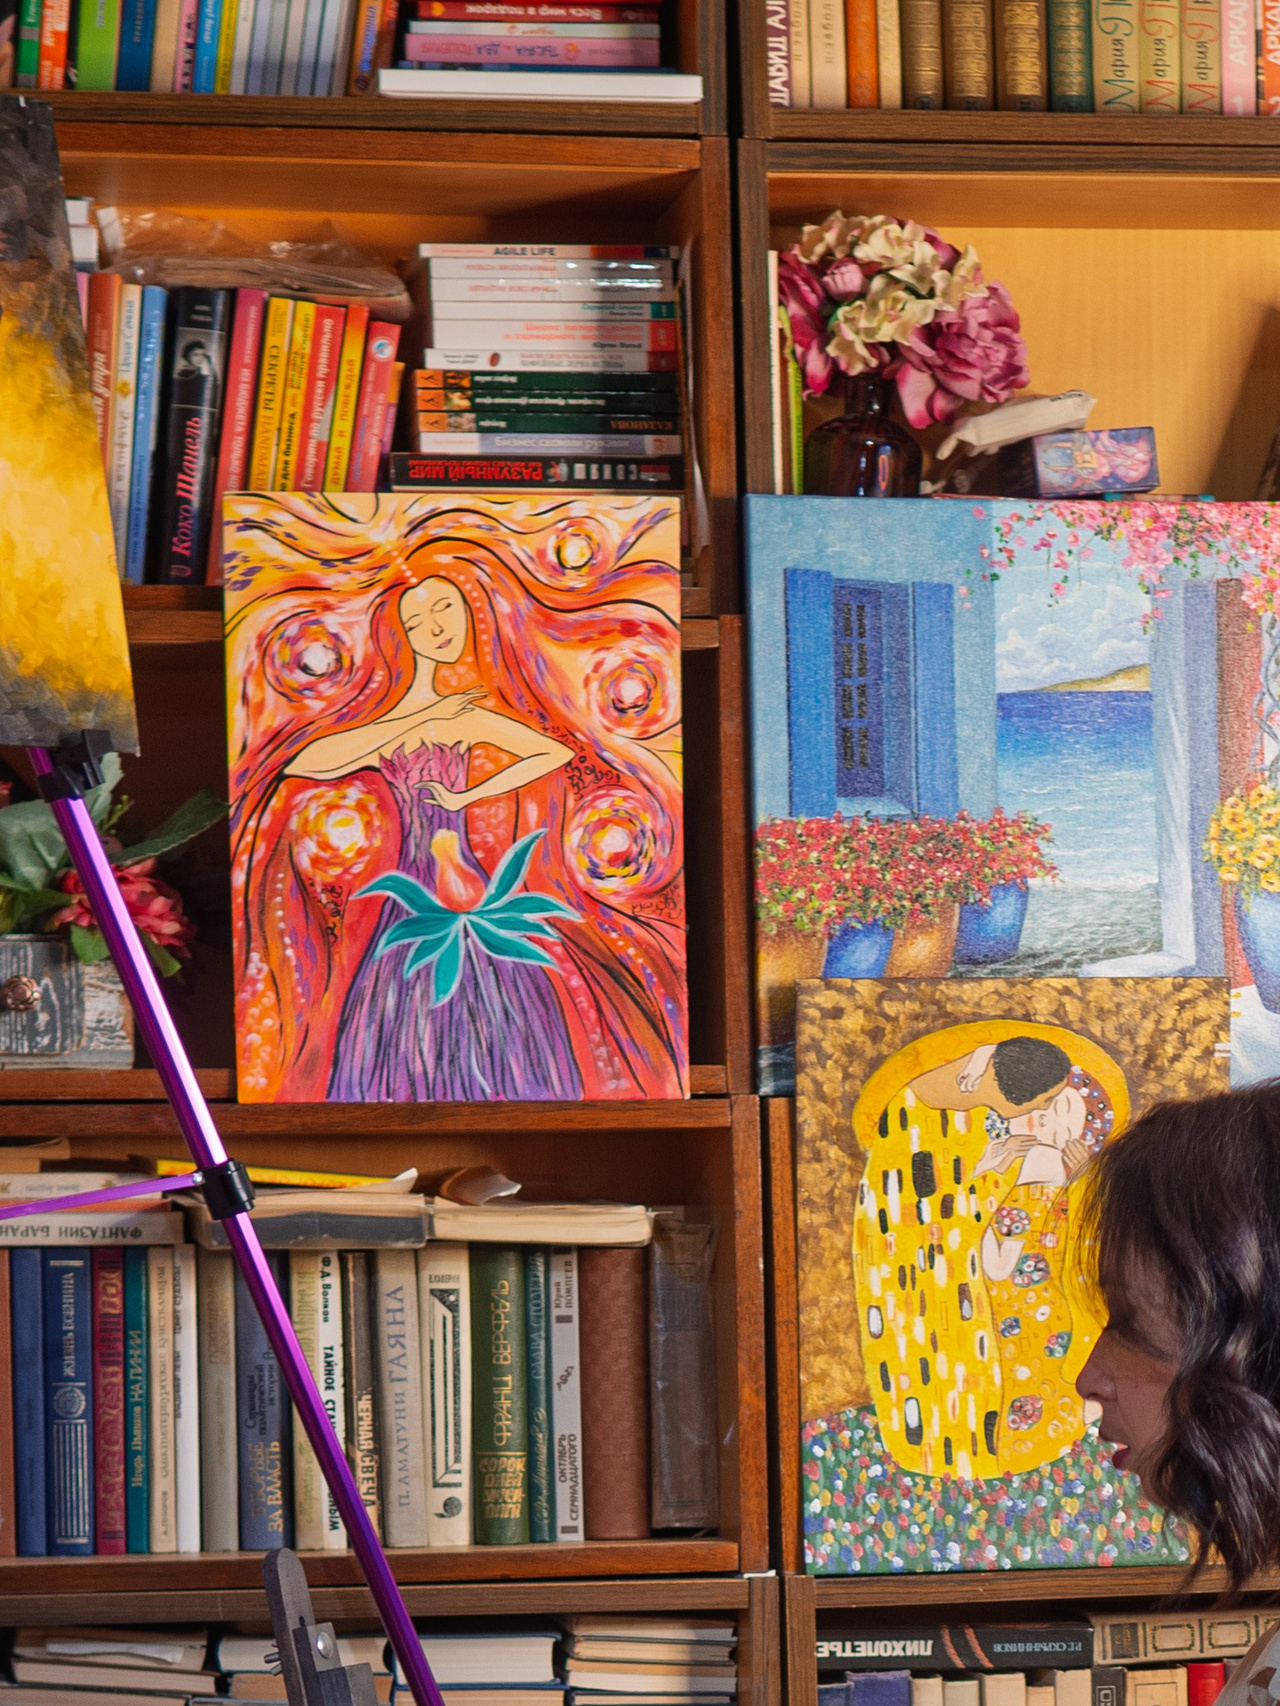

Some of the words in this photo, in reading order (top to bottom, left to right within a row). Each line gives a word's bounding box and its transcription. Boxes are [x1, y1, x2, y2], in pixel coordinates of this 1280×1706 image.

[263, 345, 280, 410] СЕКРЕТЫ
[176, 417, 202, 499] Шанель
[409, 466, 444, 481] МИР
[447, 465, 543, 483] РАЗУМНЫЙ
[172, 505, 194, 555] Коко
[384, 1285, 408, 1383] ГАЯНА
[491, 1280, 512, 1365] ВЕРФЕЛЬ
[323, 1345, 338, 1392] ТАЙНОЕ
[356, 1394, 374, 1450] ЧЕРНАЯ
[492, 1374, 513, 1446] ФРАНЦ
[266, 1440, 283, 1506] ВЛАСТЬ
[557, 1434, 568, 1483] ОКТЯБРЬ
[267, 1509, 284, 1532] ЗА
[816, 1639, 934, 1658] ЛИХОЛЕТЬЕ
